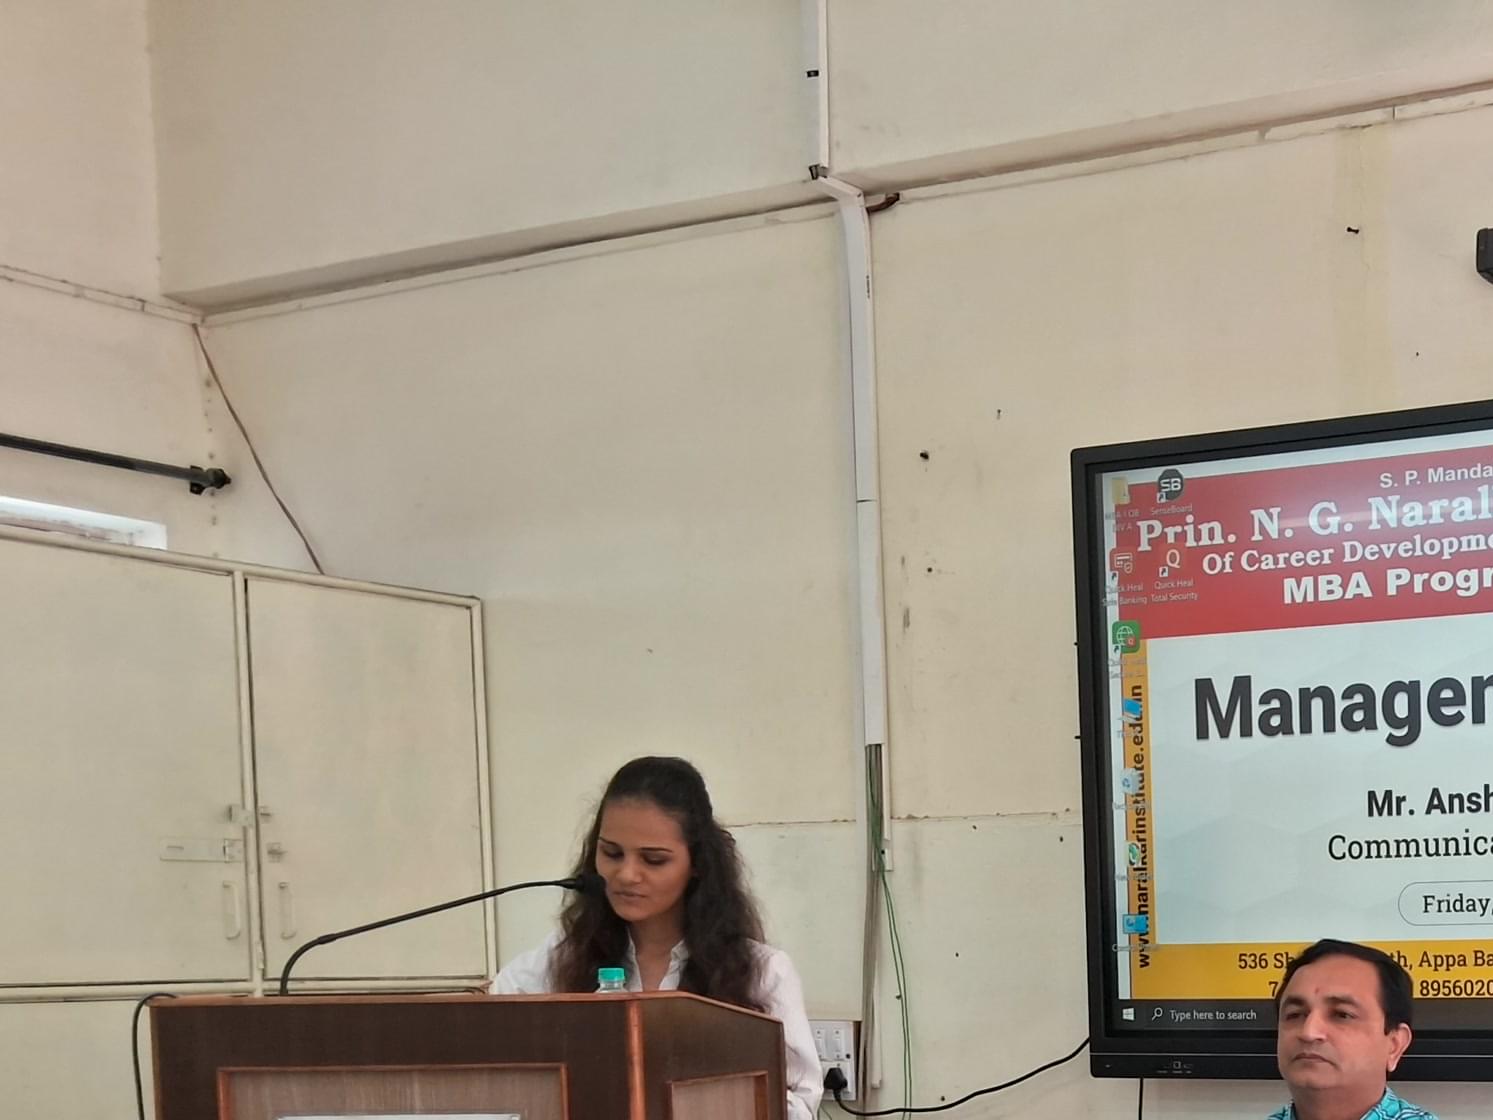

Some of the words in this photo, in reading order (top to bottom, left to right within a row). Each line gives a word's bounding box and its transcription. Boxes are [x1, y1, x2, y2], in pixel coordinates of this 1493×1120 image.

[1380, 473, 1398, 488] S.
[1405, 471, 1421, 486] P.
[1151, 503, 1193, 516] SenseBoard
[1137, 514, 1236, 551] Prin.
[1251, 507, 1293, 541] N.
[1309, 501, 1353, 535] G.
[1202, 552, 1234, 575] Of
[1241, 548, 1334, 571] Career
[1283, 571, 1372, 604] MBA
[1367, 789, 1415, 817] Mr.
[1238, 953, 1268, 969] 536
[1419, 951, 1467, 971] Appa
[1169, 1009, 1191, 1022] Type
[1193, 1009, 1213, 1020] here
[1215, 1009, 1225, 1020] to
[1227, 1009, 1257, 1020] search
